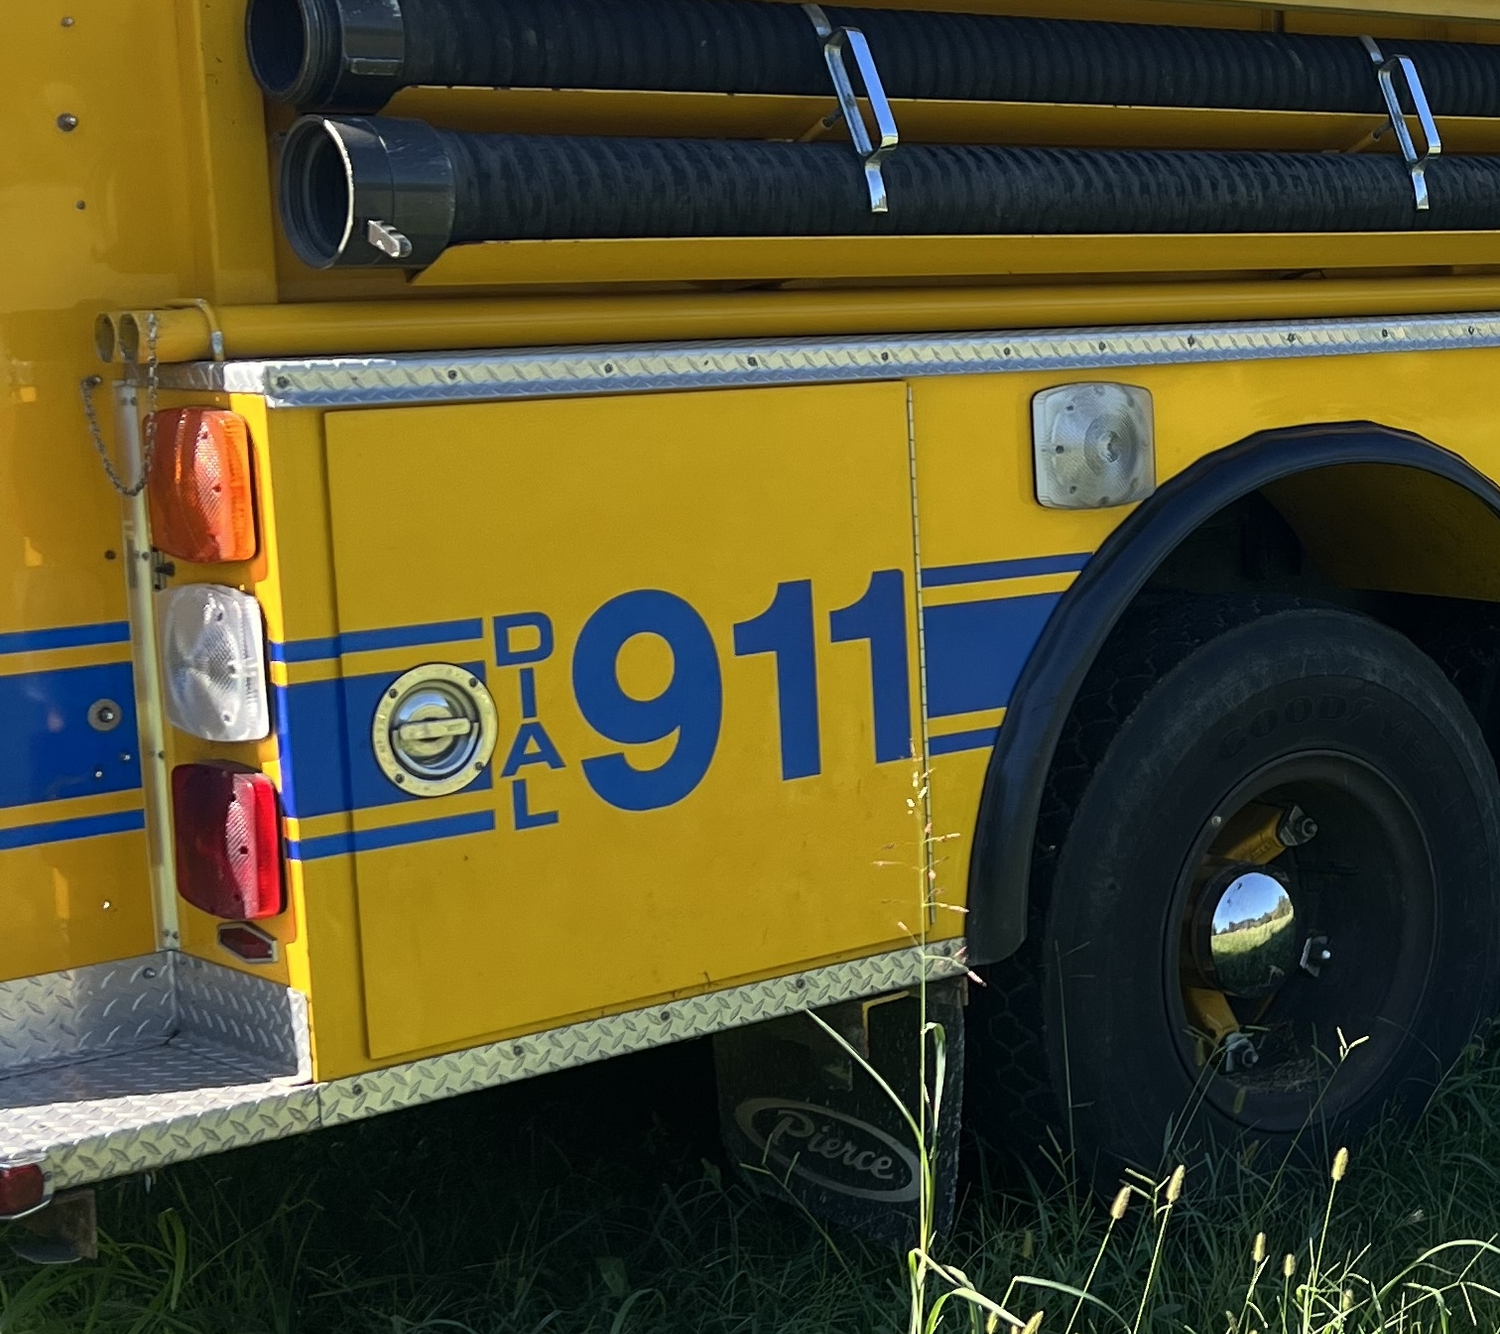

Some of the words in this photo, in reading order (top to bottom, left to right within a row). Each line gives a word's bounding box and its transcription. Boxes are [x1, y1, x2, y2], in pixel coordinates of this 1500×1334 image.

[493, 611, 565, 830] DIAL
[571, 568, 912, 812] 911
[771, 1108, 894, 1180] Pierce
